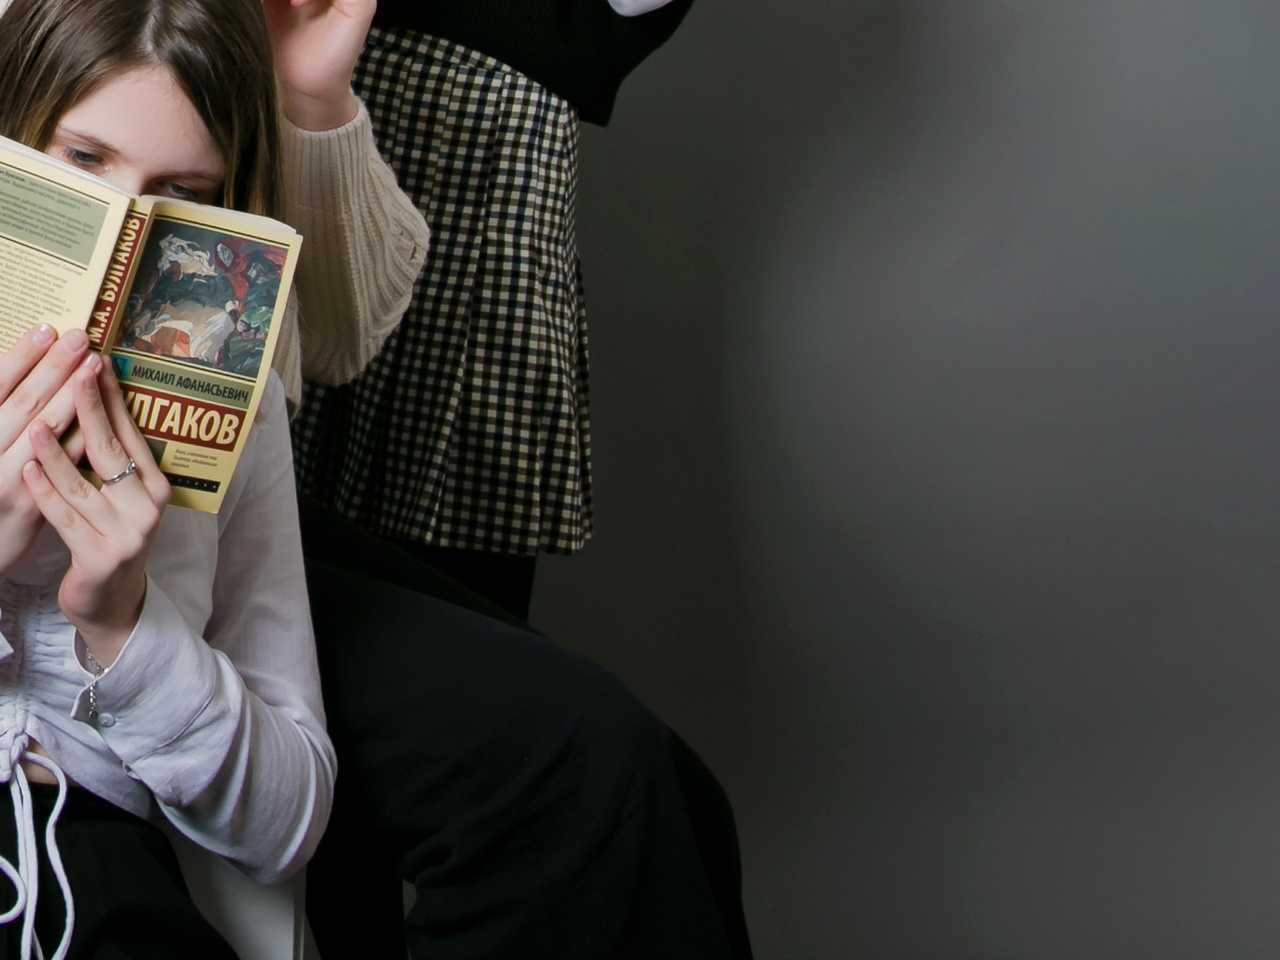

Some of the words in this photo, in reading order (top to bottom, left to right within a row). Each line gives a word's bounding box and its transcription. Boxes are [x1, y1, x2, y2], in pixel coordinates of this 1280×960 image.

[89, 305, 112, 344] М.А.
[101, 216, 141, 302] БУЛГАКОВ
[131, 365, 176, 386] МИХАИЛ
[174, 374, 249, 403] АФАНАСЬЕВИЧ
[124, 390, 240, 446] ЛГАКОВ
